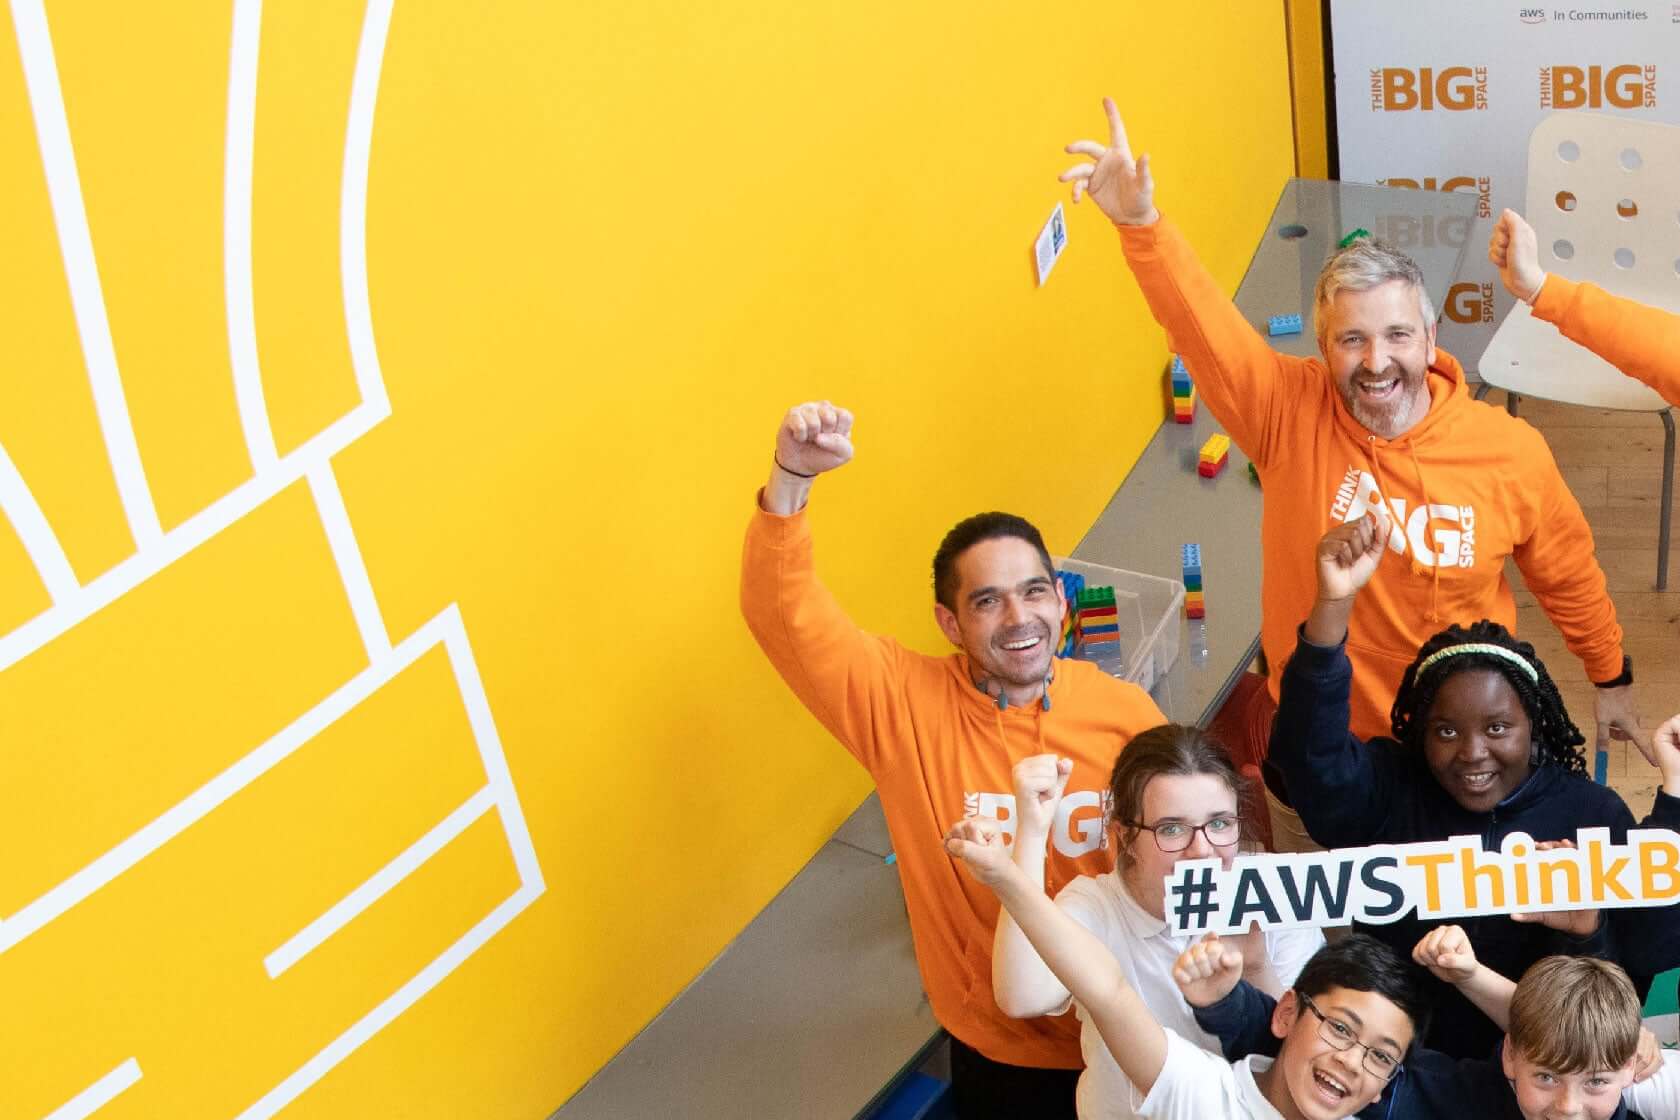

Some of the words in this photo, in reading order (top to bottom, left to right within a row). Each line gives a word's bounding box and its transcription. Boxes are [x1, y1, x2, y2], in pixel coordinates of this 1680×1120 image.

[1520, 8, 1545, 18] aws
[1554, 10, 1565, 21] In
[1569, 9, 1648, 21] Communities
[1370, 68, 1382, 112] THINK
[1382, 66, 1476, 111] BIG
[1476, 66, 1488, 110] SPACE
[1540, 67, 1550, 109] THINK
[1551, 64, 1644, 109] BIG
[1644, 64, 1656, 107] SPACE
[1478, 176, 1491, 219] SPACE
[1482, 282, 1494, 323] SPACE
[1330, 464, 1360, 521] THINK
[1459, 504, 1475, 568] SPACE
[979, 791, 1103, 858] BG
